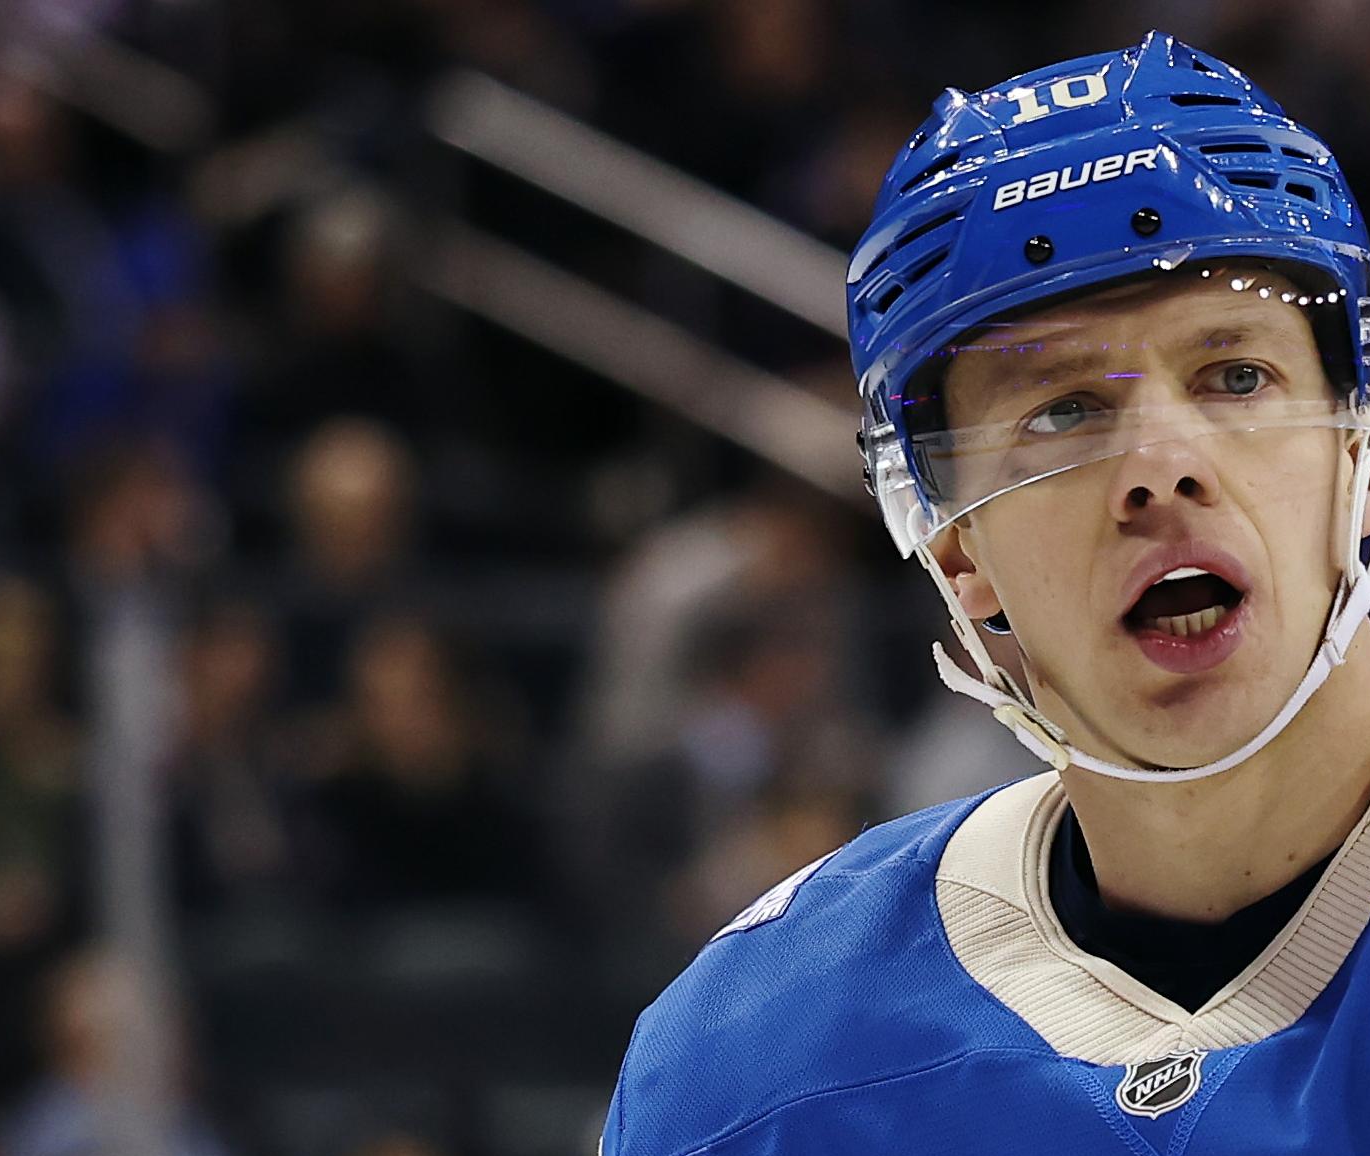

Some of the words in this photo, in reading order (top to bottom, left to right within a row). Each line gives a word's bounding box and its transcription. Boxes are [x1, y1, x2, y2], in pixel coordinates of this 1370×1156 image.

[1007, 74, 1108, 124] 10
[993, 148, 1158, 211] BAUER
[1134, 1063, 1188, 1102] NHL
